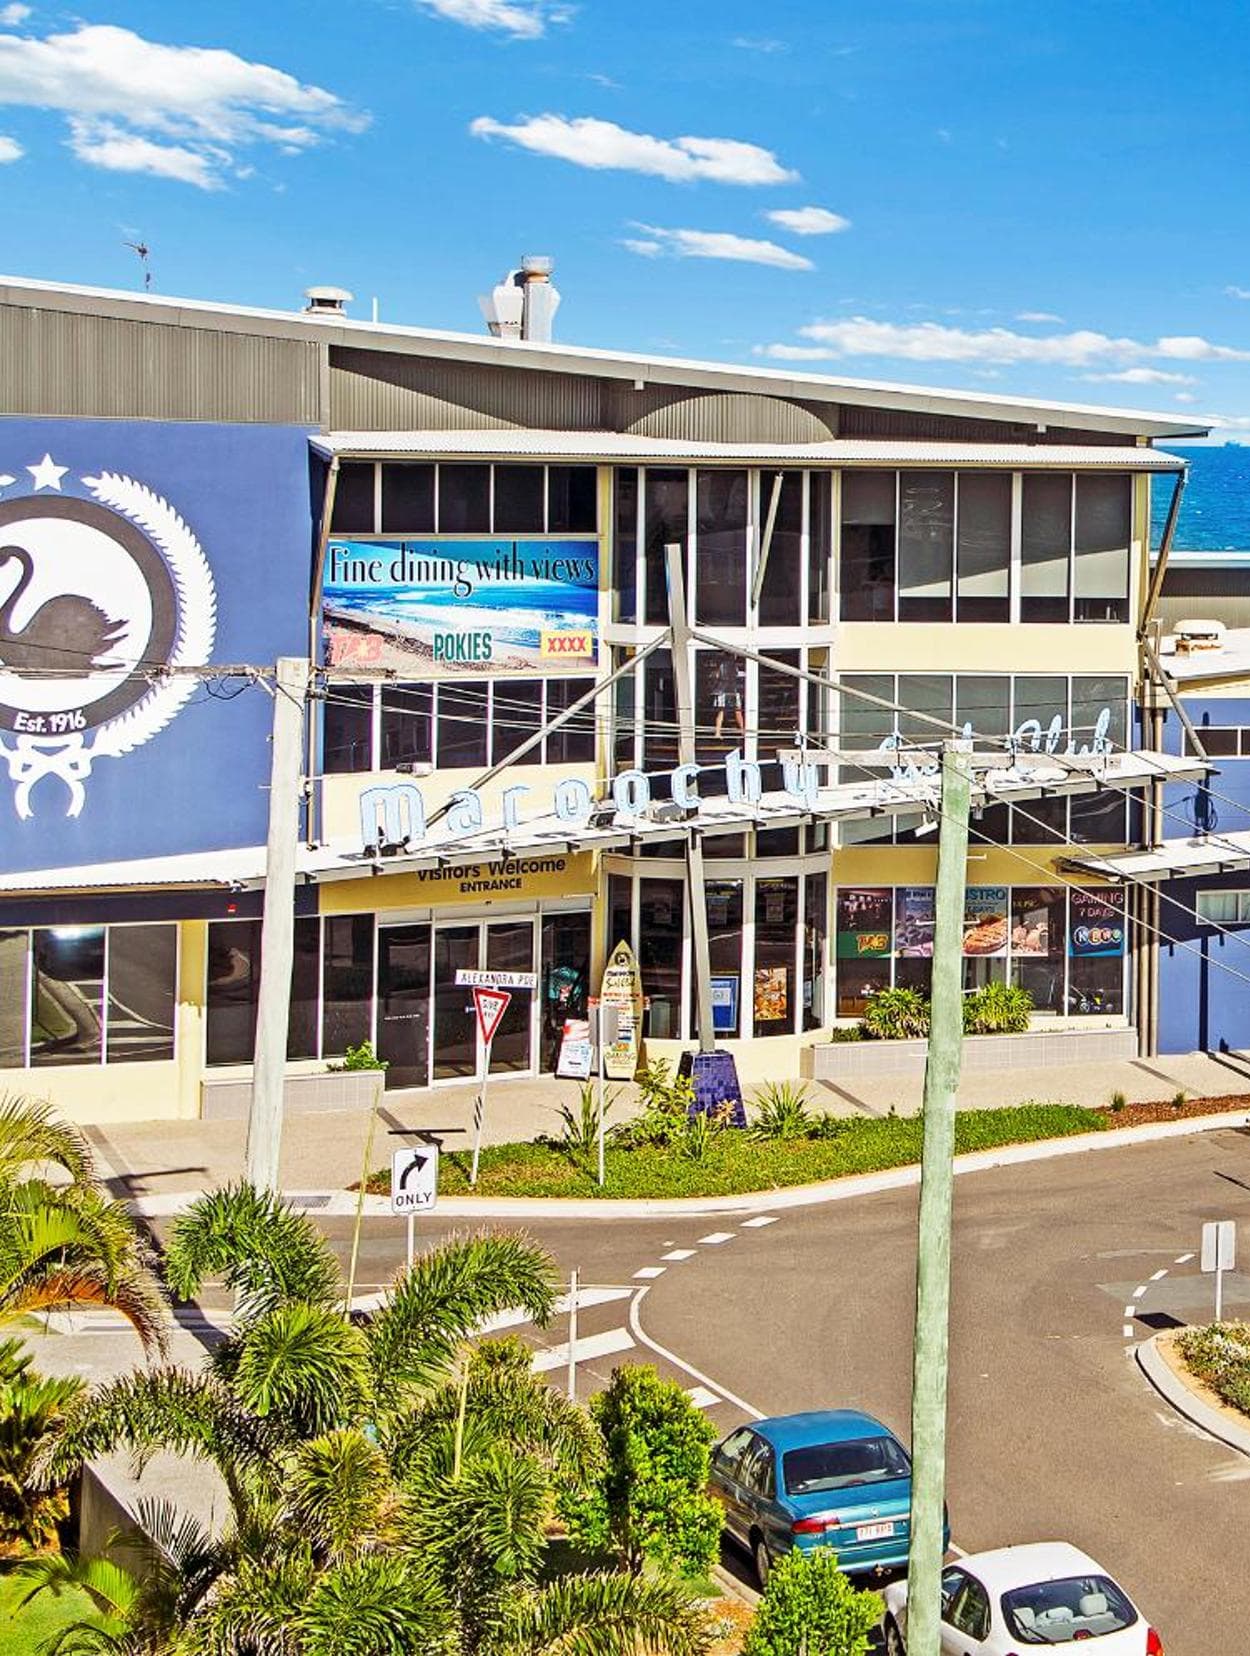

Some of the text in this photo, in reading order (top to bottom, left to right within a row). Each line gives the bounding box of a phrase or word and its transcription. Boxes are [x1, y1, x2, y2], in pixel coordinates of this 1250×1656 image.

[329, 539, 596, 599] Fine dining with views
[433, 632, 493, 662] POKIES
[546, 637, 587, 654] XXXX
[13, 709, 88, 733] Est. 1916
[417, 857, 567, 882] Visitors Welcome
[459, 877, 523, 894] ENTRANCE
[964, 888, 1006, 901] ISTRO
[460, 972, 515, 986] ALEXANDRA
[395, 1191, 433, 1208] ONLY
